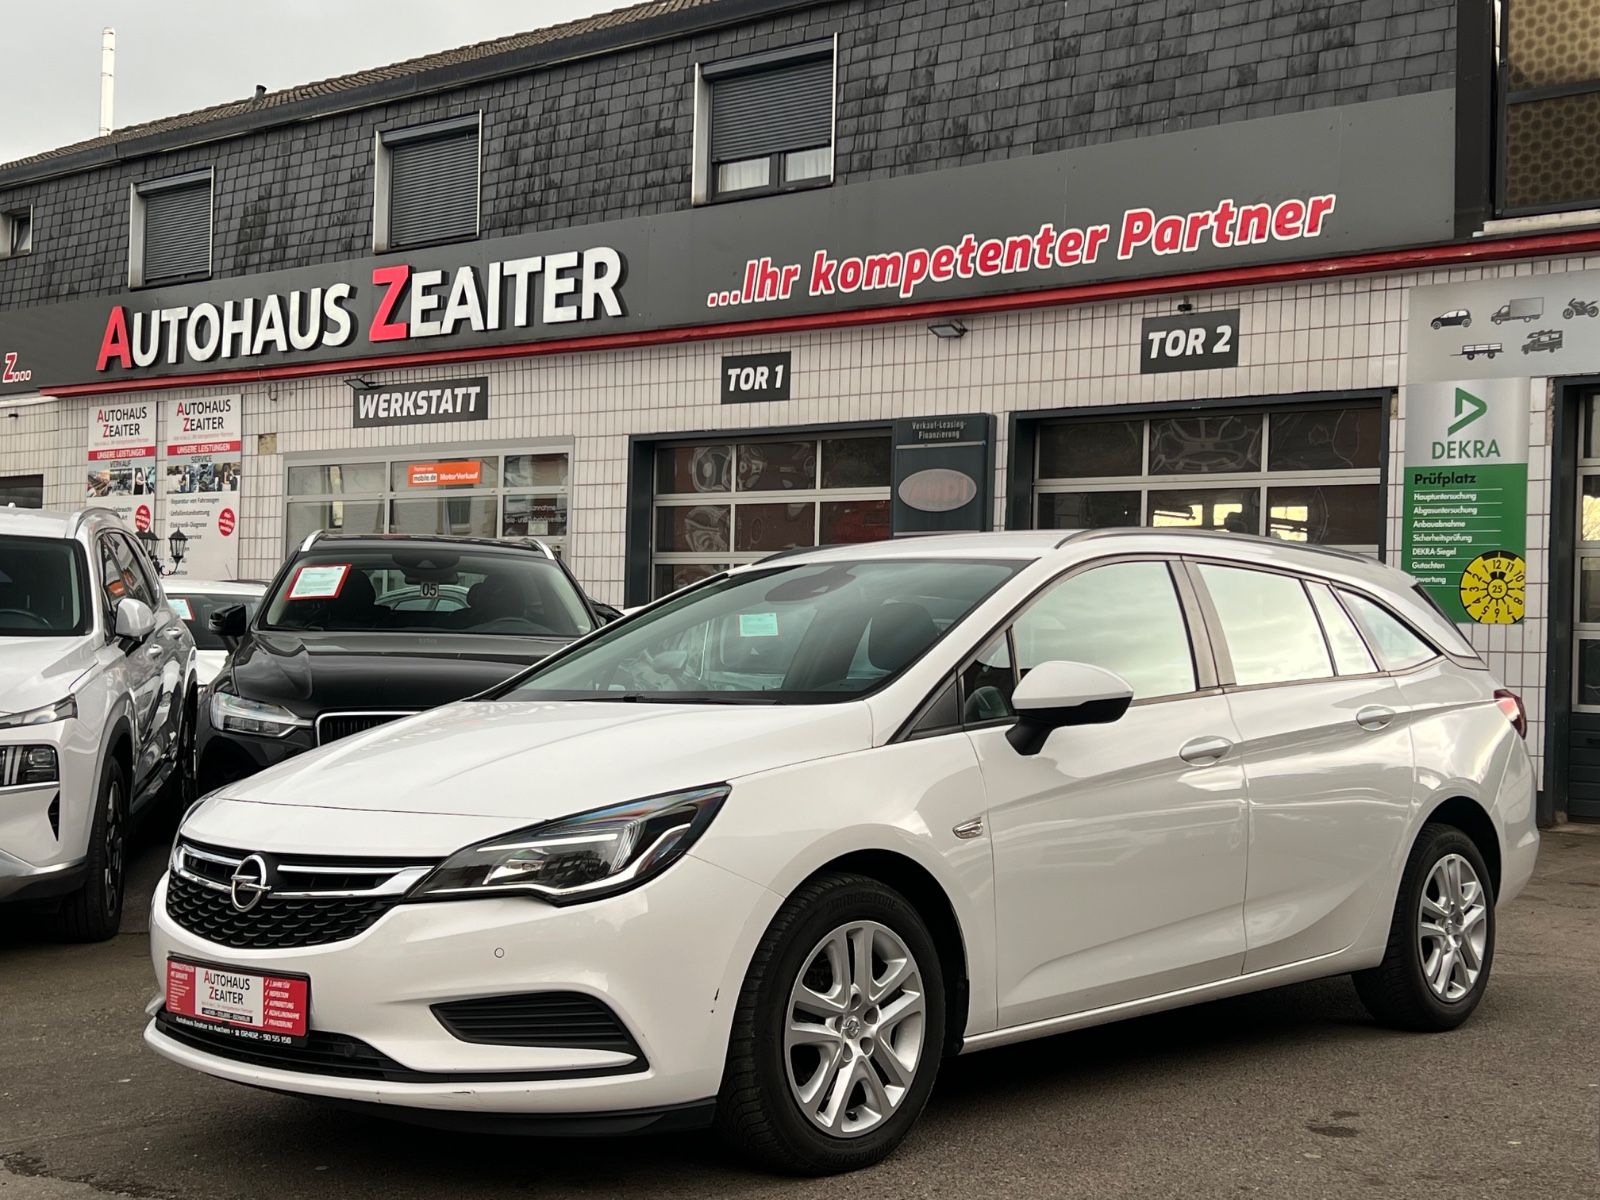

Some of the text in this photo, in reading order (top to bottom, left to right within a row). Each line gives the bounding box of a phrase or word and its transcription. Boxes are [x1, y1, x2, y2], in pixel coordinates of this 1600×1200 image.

[707, 193, 1337, 308] ...Ihr kompetenter Partner
[96, 246, 622, 371] AUTOHAUS ZEAITER
[1147, 325, 1232, 359] TOR 2
[728, 365, 784, 392] TOR 1
[177, 399, 231, 416] AUTOHAUS
[358, 386, 480, 420] WERKSTATT
[97, 406, 147, 423] AUTOHAUS
[183, 417, 224, 432] ZEAITER
[103, 423, 140, 438] ZEAITER
[919, 430, 960, 439] Finanzierung
[97, 448, 146, 459] UNSERE LEISTUNGEN
[176, 443, 231, 454] UNSERE LEISTUNGEN
[1432, 439, 1501, 459] DEKRA
[191, 455, 212, 463] SERVICE
[1414, 472, 1476, 487] Prüfplatz
[1413, 492, 1477, 502] Hauptuntersuchung
[1413, 506, 1477, 516] Abgasuntersuchung
[1413, 520, 1466, 529] Anbauabnahme
[1413, 533, 1472, 543] Sicherheitsprüfung
[1411, 561, 1445, 569] Gutachten
[1493, 560, 1501, 569] 12
[1506, 561, 1515, 572] 11
[1472, 573, 1482, 582] 2
[422, 584, 437, 596] 05
[1492, 585, 1502, 593] 25
[1513, 597, 1523, 605] 8
[1481, 605, 1490, 615] 5
[1494, 608, 1500, 618] 6
[204, 970, 250, 991] AUTOHAUS
[209, 986, 244, 1005] ZEAITER
[263, 1033, 271, 1041] 90
